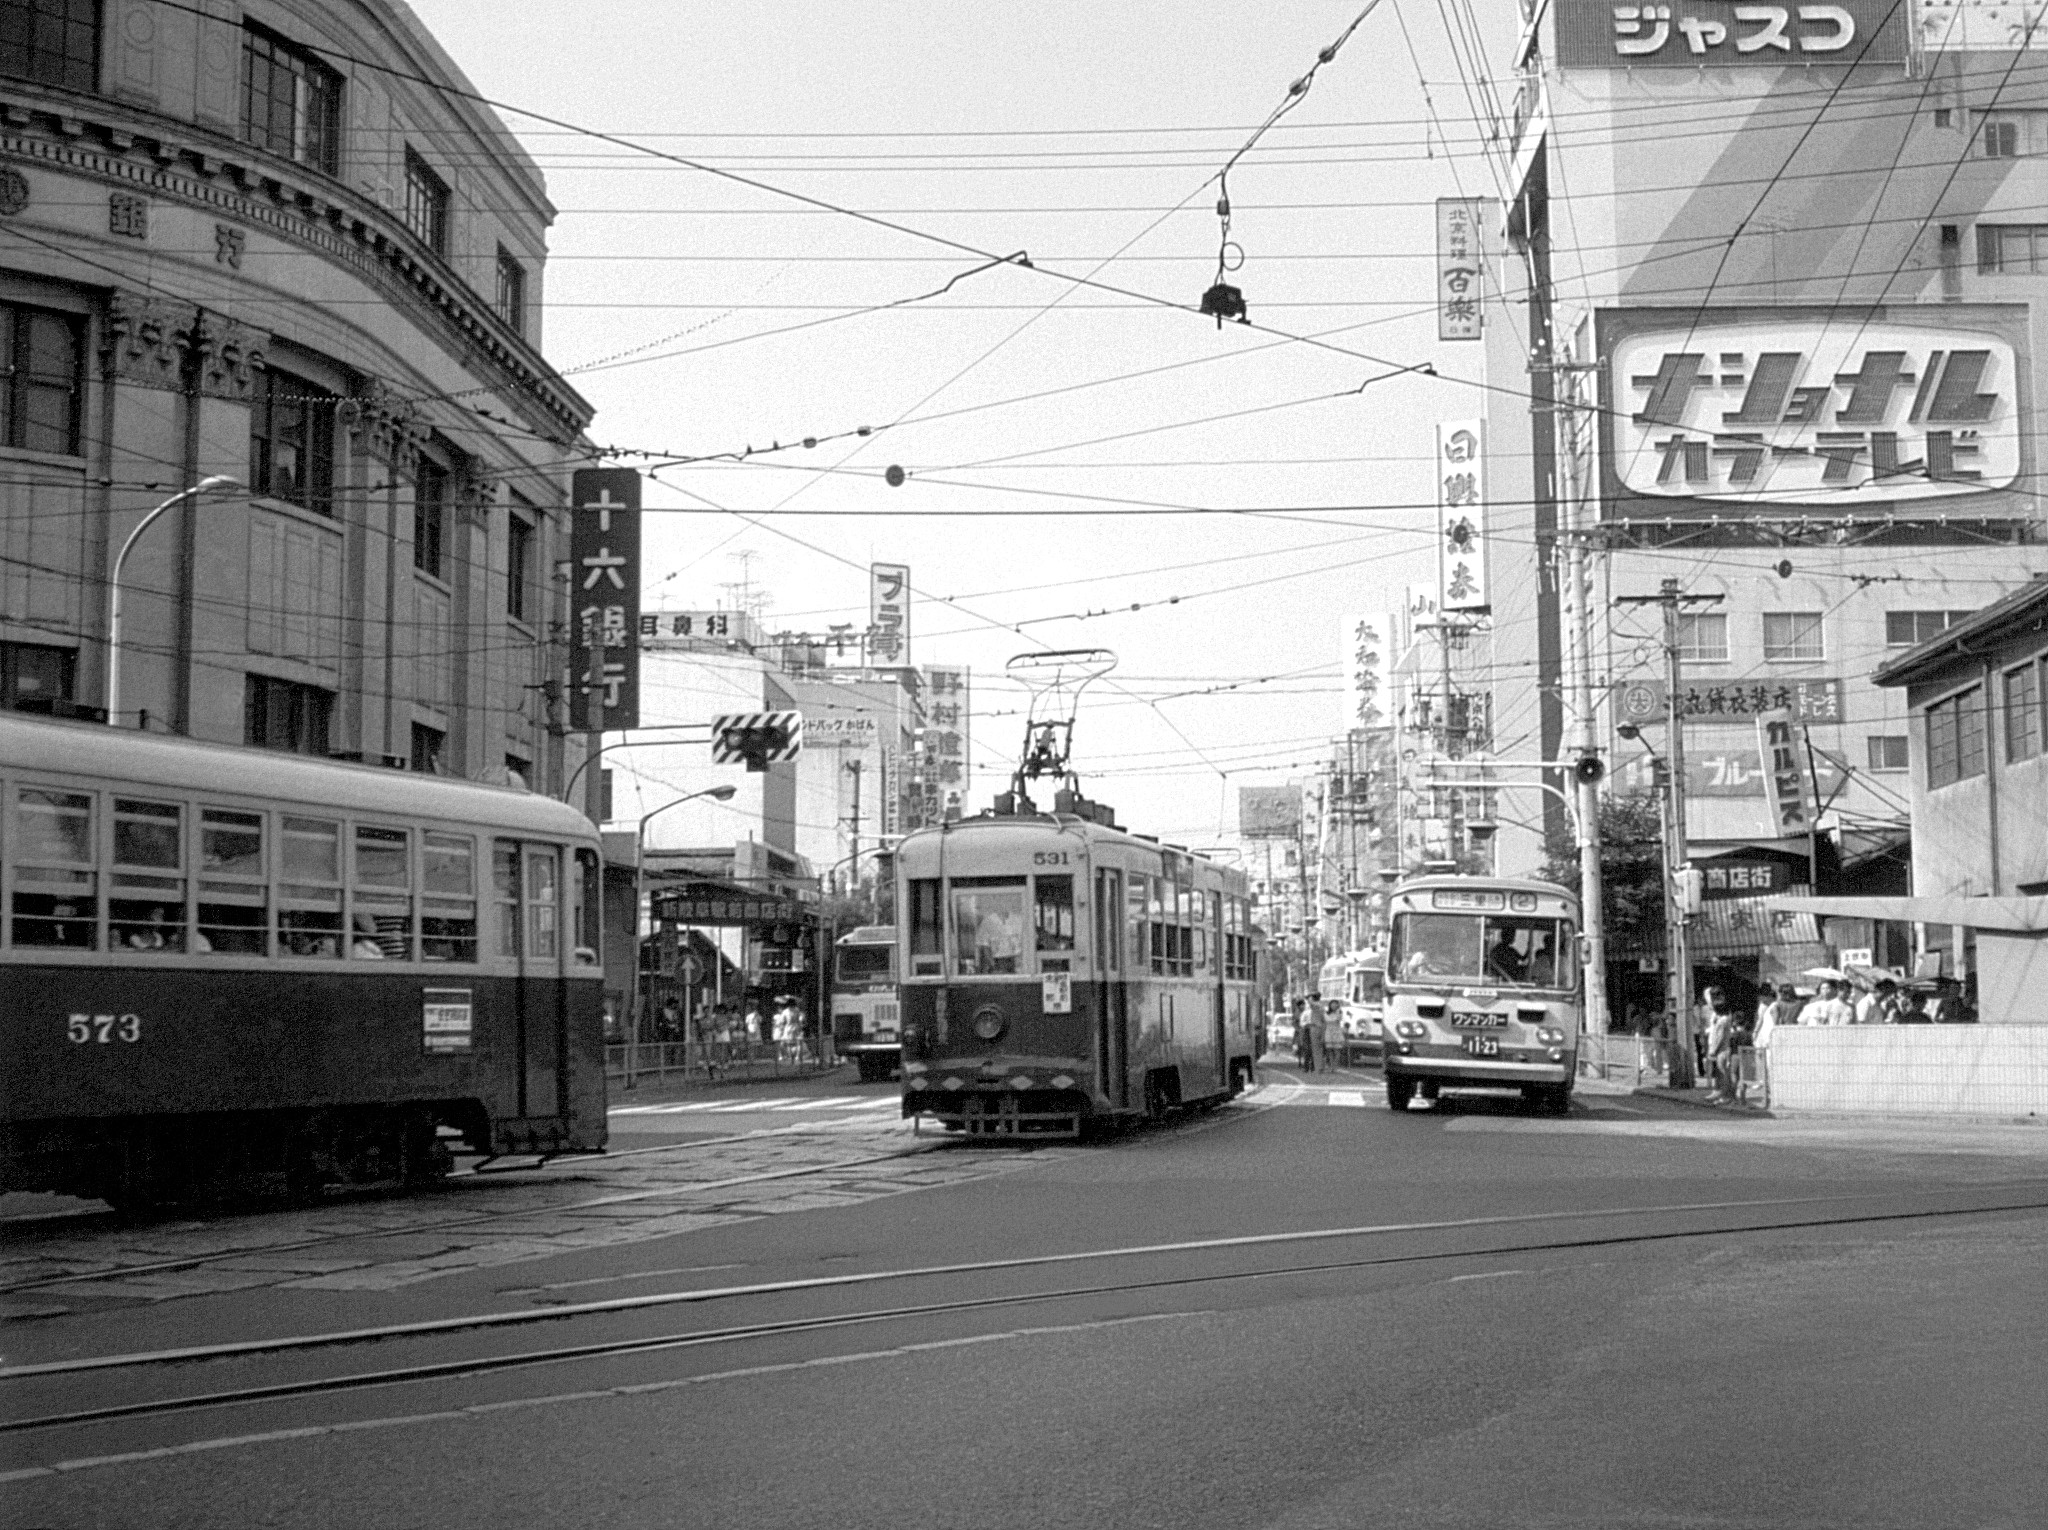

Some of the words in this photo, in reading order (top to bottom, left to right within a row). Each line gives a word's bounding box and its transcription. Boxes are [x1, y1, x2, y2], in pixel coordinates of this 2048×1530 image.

[1612, 4, 1857, 55] ジャスコ
[1631, 348, 2003, 425] ナショナル
[1653, 428, 1983, 484] カラーテレビ
[580, 487, 628, 708] 十六銀行
[1766, 720, 1804, 826] カルピス
[1033, 850, 1070, 866] 531
[1705, 865, 1772, 890] 商店街
[65, 1013, 141, 1044] 573
[1453, 1012, 1507, 1026] ワンマンカー
